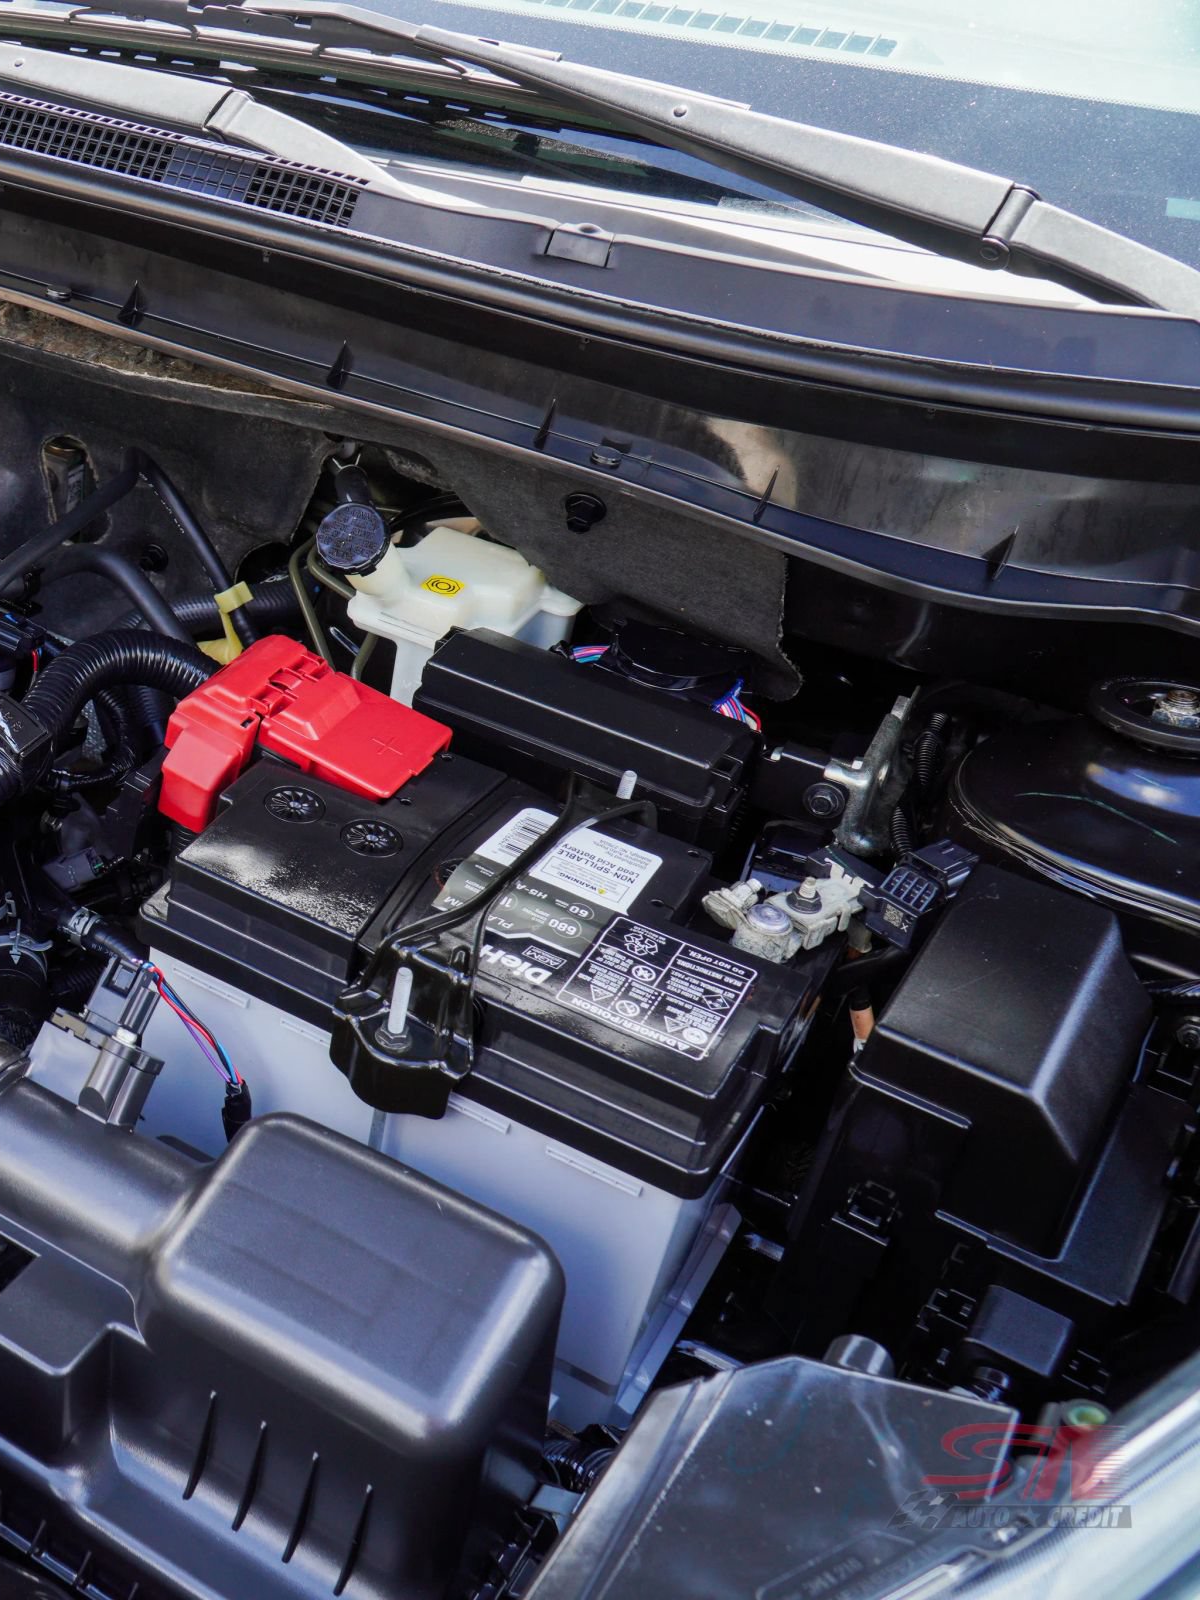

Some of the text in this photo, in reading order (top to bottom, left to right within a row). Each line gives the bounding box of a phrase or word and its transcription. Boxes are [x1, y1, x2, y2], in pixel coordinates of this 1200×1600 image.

[560, 842, 596, 860] Battery
[556, 847, 636, 885] NON-SPILLABLE
[596, 857, 617, 869] Acid
[616, 865, 640, 878] Lead
[555, 870, 598, 891] WARNING:
[514, 882, 548, 899] H5-A
[568, 904, 589, 917] 60
[546, 917, 578, 936] 680
[473, 943, 553, 986] DieH
[525, 950, 559, 967] AGM
[686, 948, 745, 975] DO NOT OPEN.
[722, 975, 742, 987] READ
[570, 996, 678, 1046] DANGER/POISON
